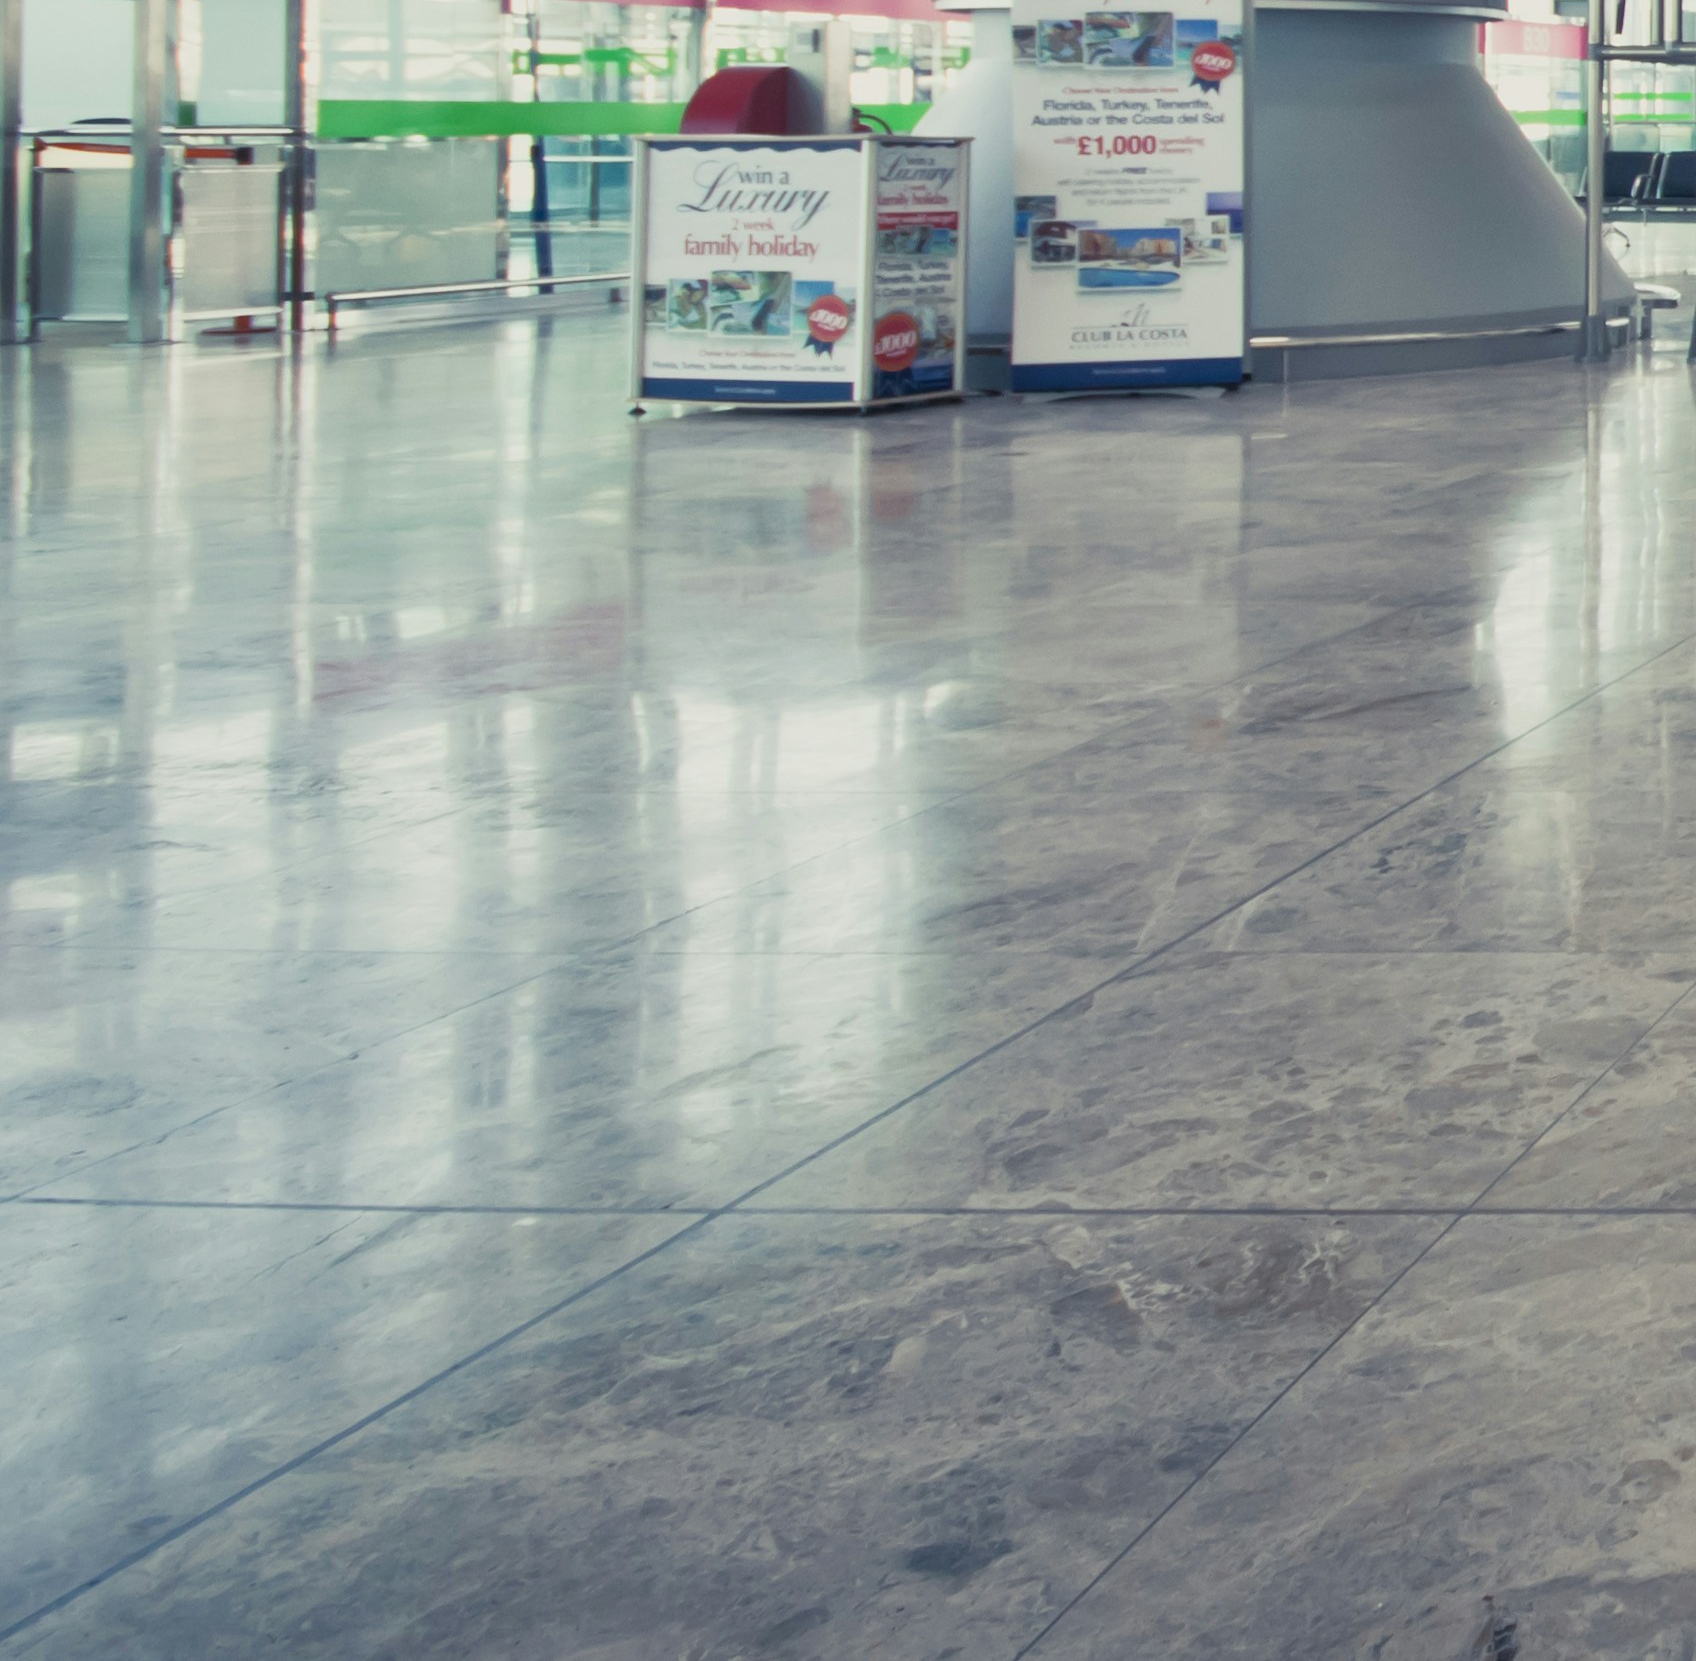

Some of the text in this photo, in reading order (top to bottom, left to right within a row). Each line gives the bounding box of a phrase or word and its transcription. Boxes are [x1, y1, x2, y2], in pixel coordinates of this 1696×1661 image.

[1043, 98, 1213, 112] Florida, Turkey, Tenerife,
[1031, 113, 1224, 126] Austria or the Costa del Sol
[1077, 135, 1157, 159] £1,000
[738, 165, 790, 185] win a
[677, 160, 831, 231] Luxury
[732, 218, 775, 231] 2 week
[684, 234, 820, 263] family holiday
[1071, 328, 1188, 344] CLUB LA COSTA
